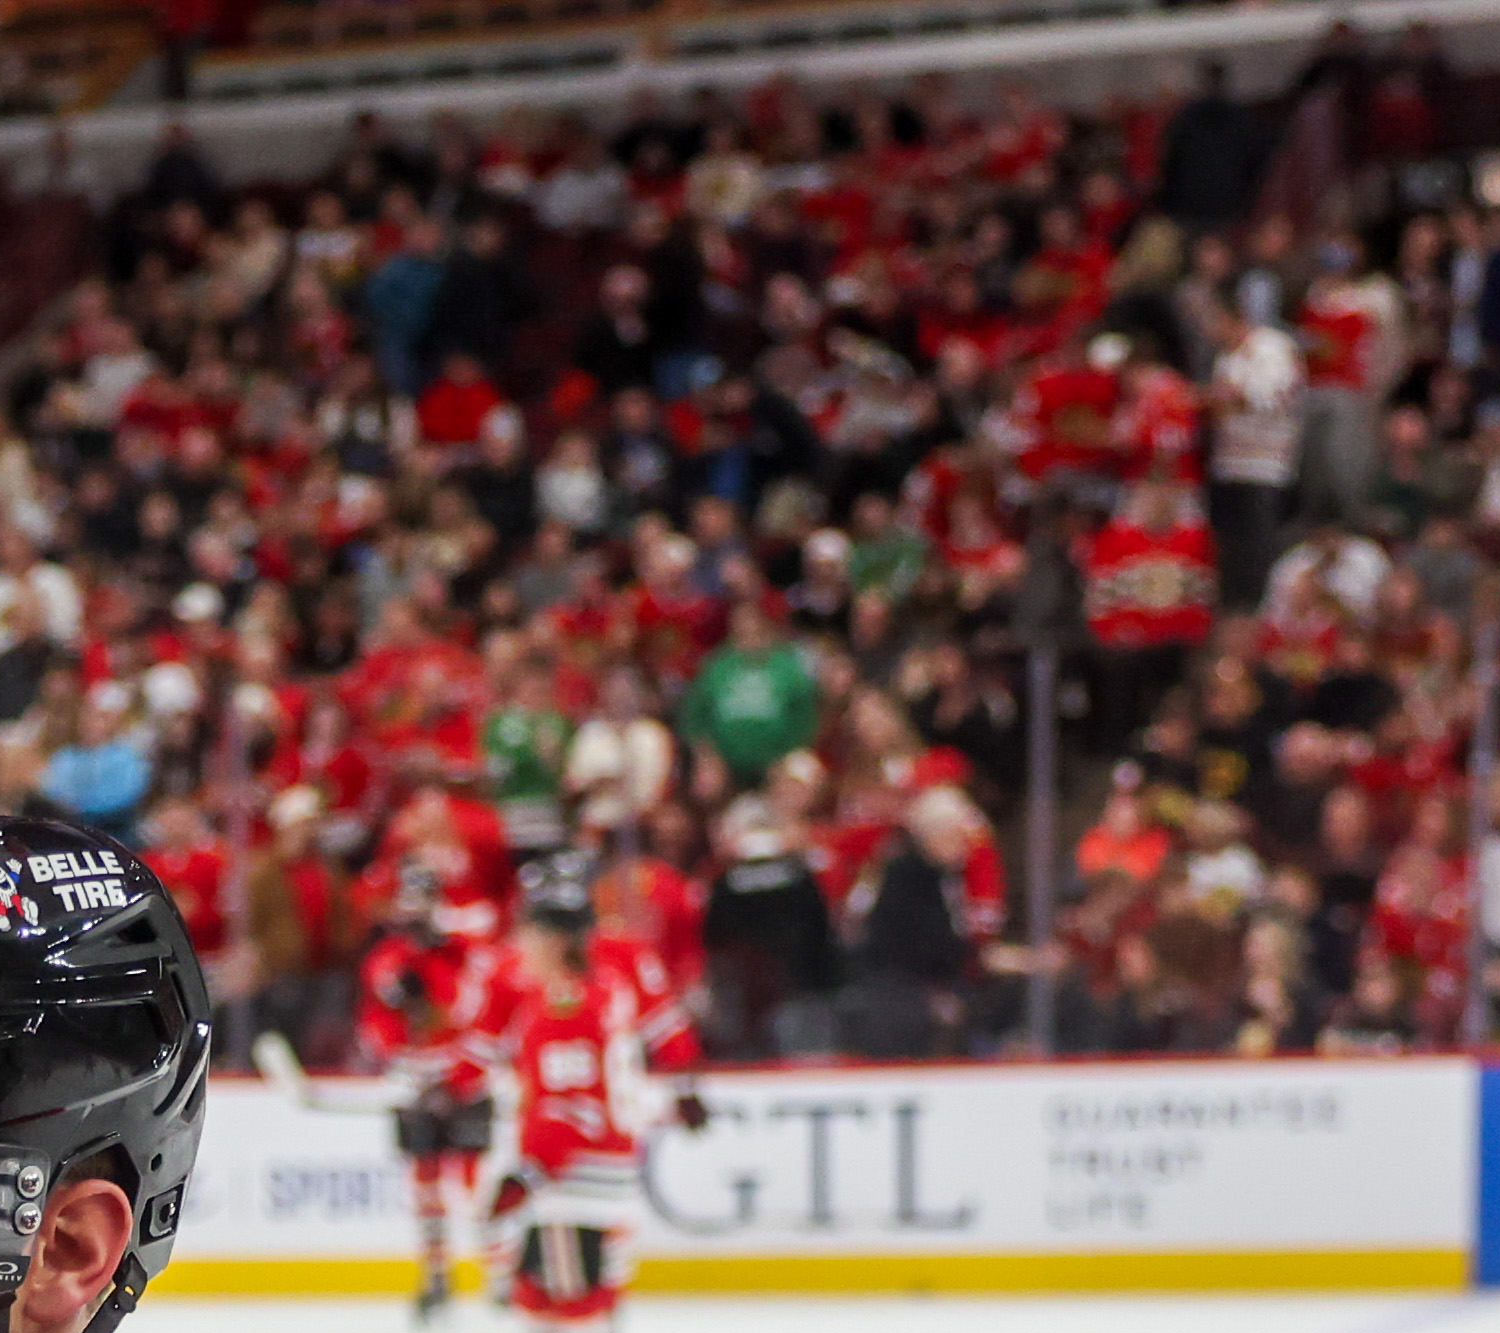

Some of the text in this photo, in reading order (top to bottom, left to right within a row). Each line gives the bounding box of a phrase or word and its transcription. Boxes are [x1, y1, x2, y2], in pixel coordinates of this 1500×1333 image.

[27, 850, 125, 883] BELLE
[52, 878, 128, 913] TIRE
[640, 1098, 980, 1236] GTL
